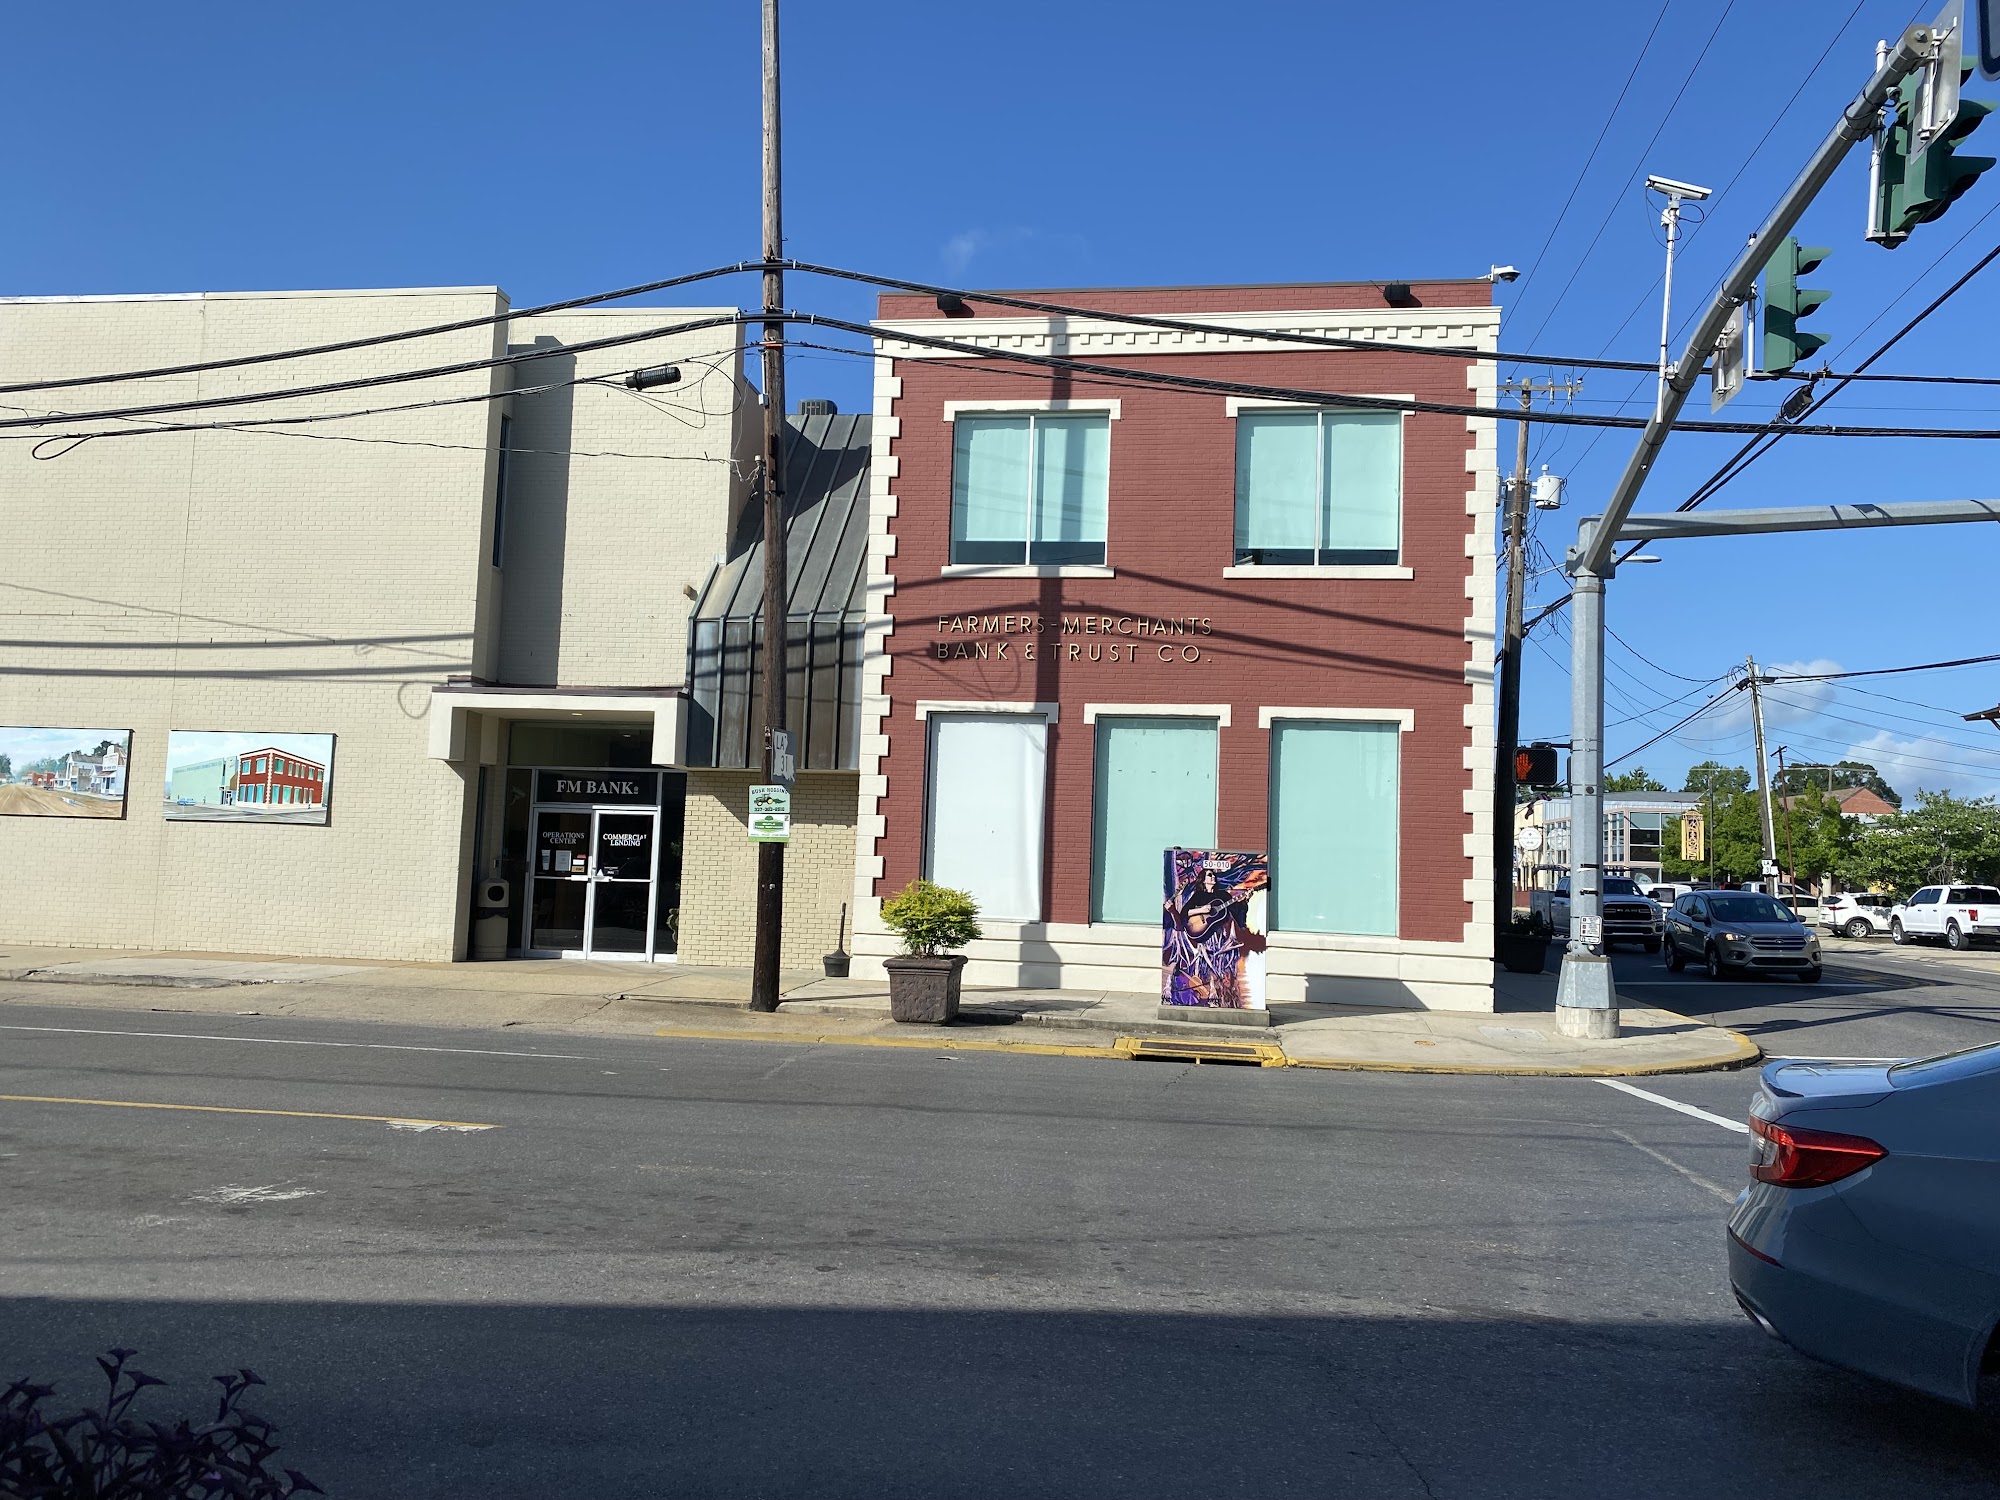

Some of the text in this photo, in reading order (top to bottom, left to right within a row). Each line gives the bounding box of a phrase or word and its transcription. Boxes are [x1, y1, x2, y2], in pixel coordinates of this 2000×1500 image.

[937, 615, 1212, 635] FARMERS-MERCHANTS
[937, 642, 1213, 663] BANK & TRUST CO.
[776, 735, 785, 751] LA
[780, 755, 788, 773] 31
[556, 780, 634, 795] FM BANK
[542, 831, 585, 839] OPERATIONS
[549, 837, 577, 845] CENTER
[609, 839, 641, 847] LENDING
